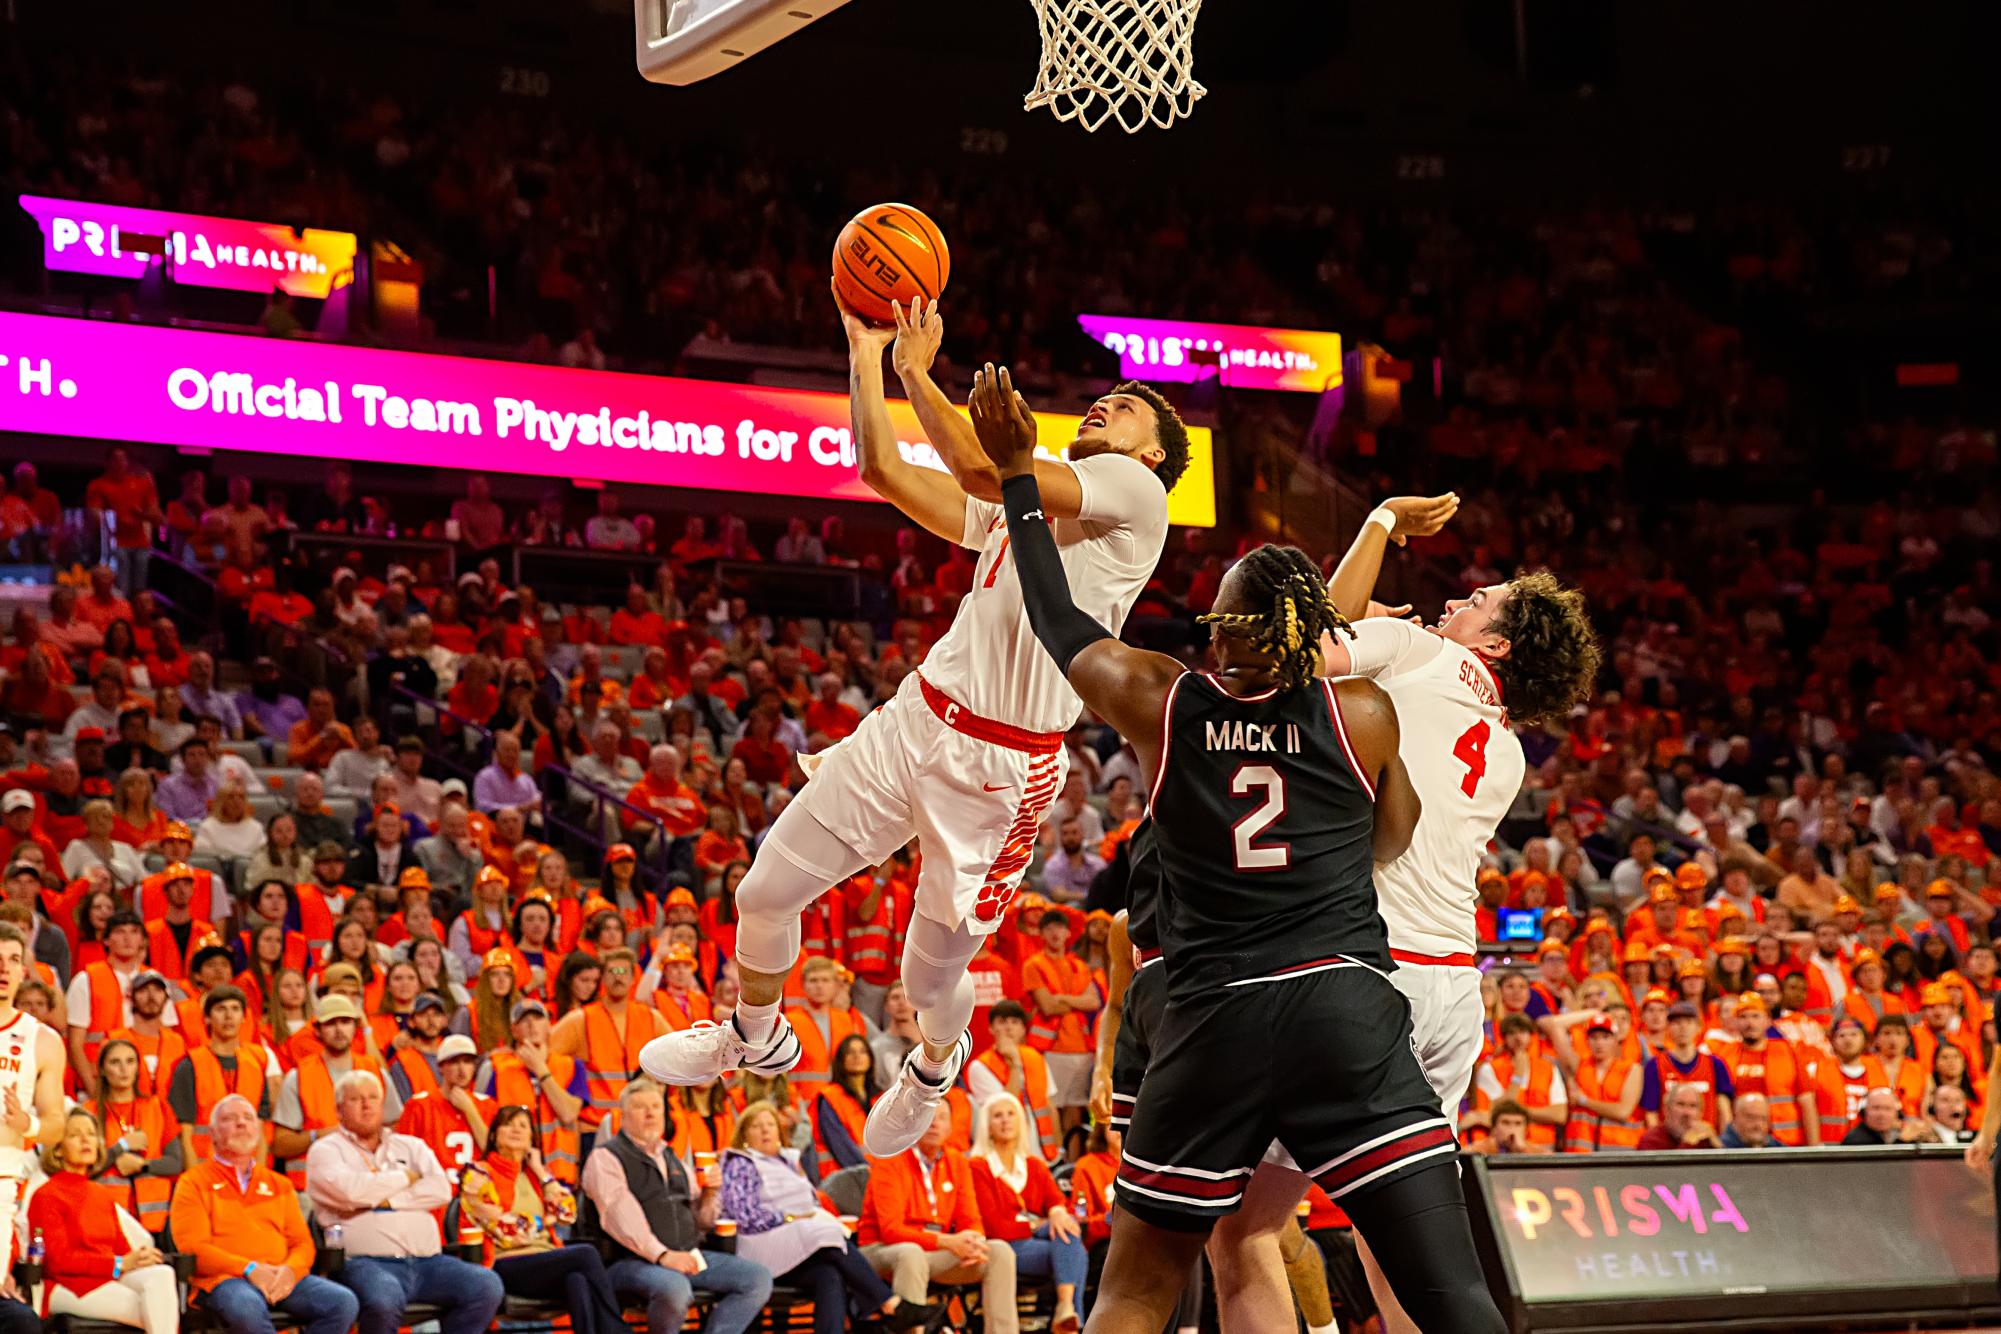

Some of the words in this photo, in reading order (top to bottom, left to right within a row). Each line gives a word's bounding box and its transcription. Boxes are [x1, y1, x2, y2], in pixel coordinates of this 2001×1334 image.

[850, 235, 901, 288] ELITE
[167, 367, 343, 423] Official
[351, 383, 482, 436] Team
[493, 397, 725, 456] Physicians
[735, 419, 799, 462] for
[945, 703, 960, 725] C
[1205, 721, 1277, 752] MACK
[1287, 723, 1301, 754] II
[1453, 718, 1490, 799] 4
[1230, 763, 1290, 870] 2
[1511, 1183, 1750, 1240] PRISMA
